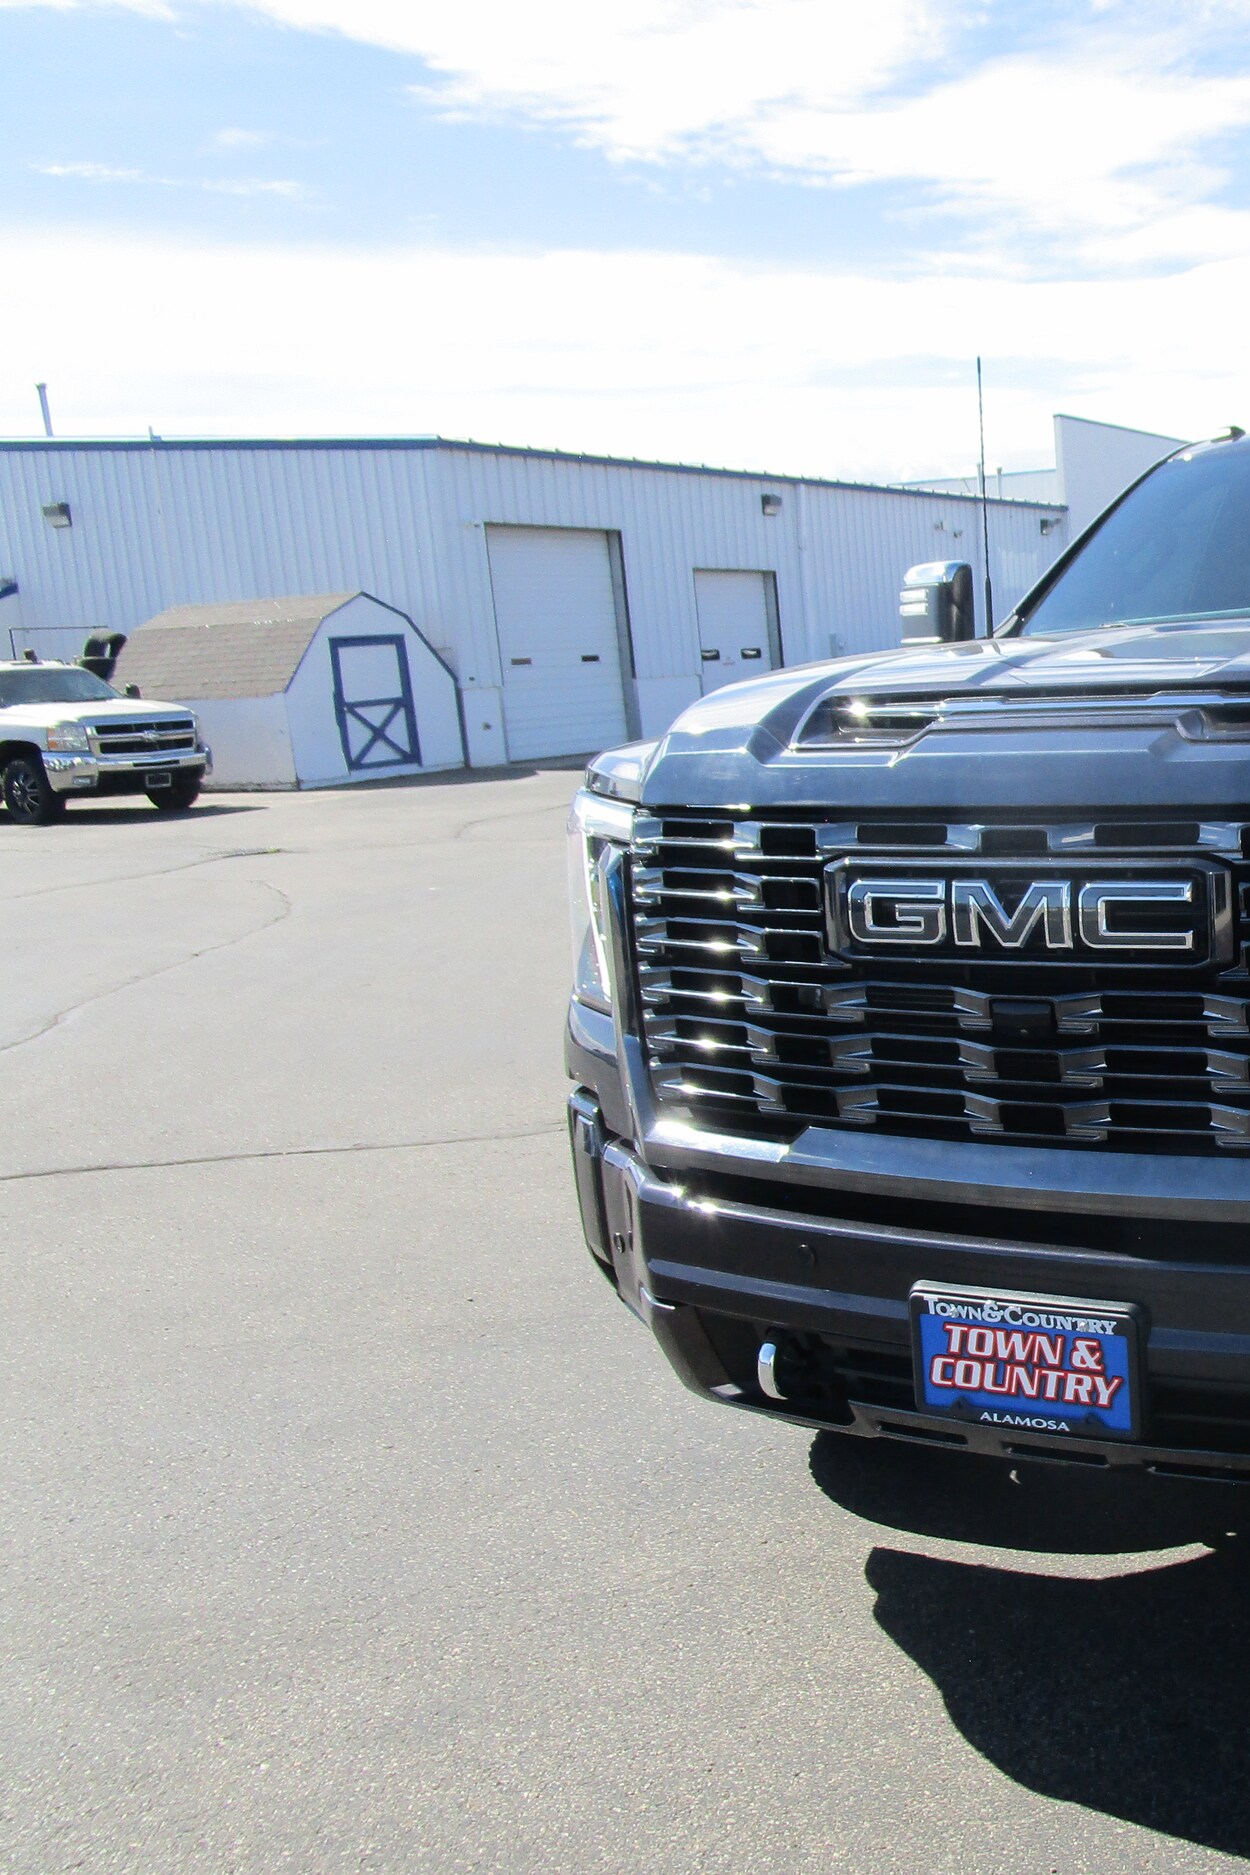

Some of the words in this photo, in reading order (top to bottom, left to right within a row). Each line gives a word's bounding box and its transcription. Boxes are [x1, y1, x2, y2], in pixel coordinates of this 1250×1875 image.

[848, 880, 1194, 949] GMC
[944, 1322, 1064, 1368] TOWN
[1072, 1337, 1103, 1371] &
[930, 1354, 1122, 1408] COUNTRY
[980, 1411, 1070, 1432] ALAMOSA
